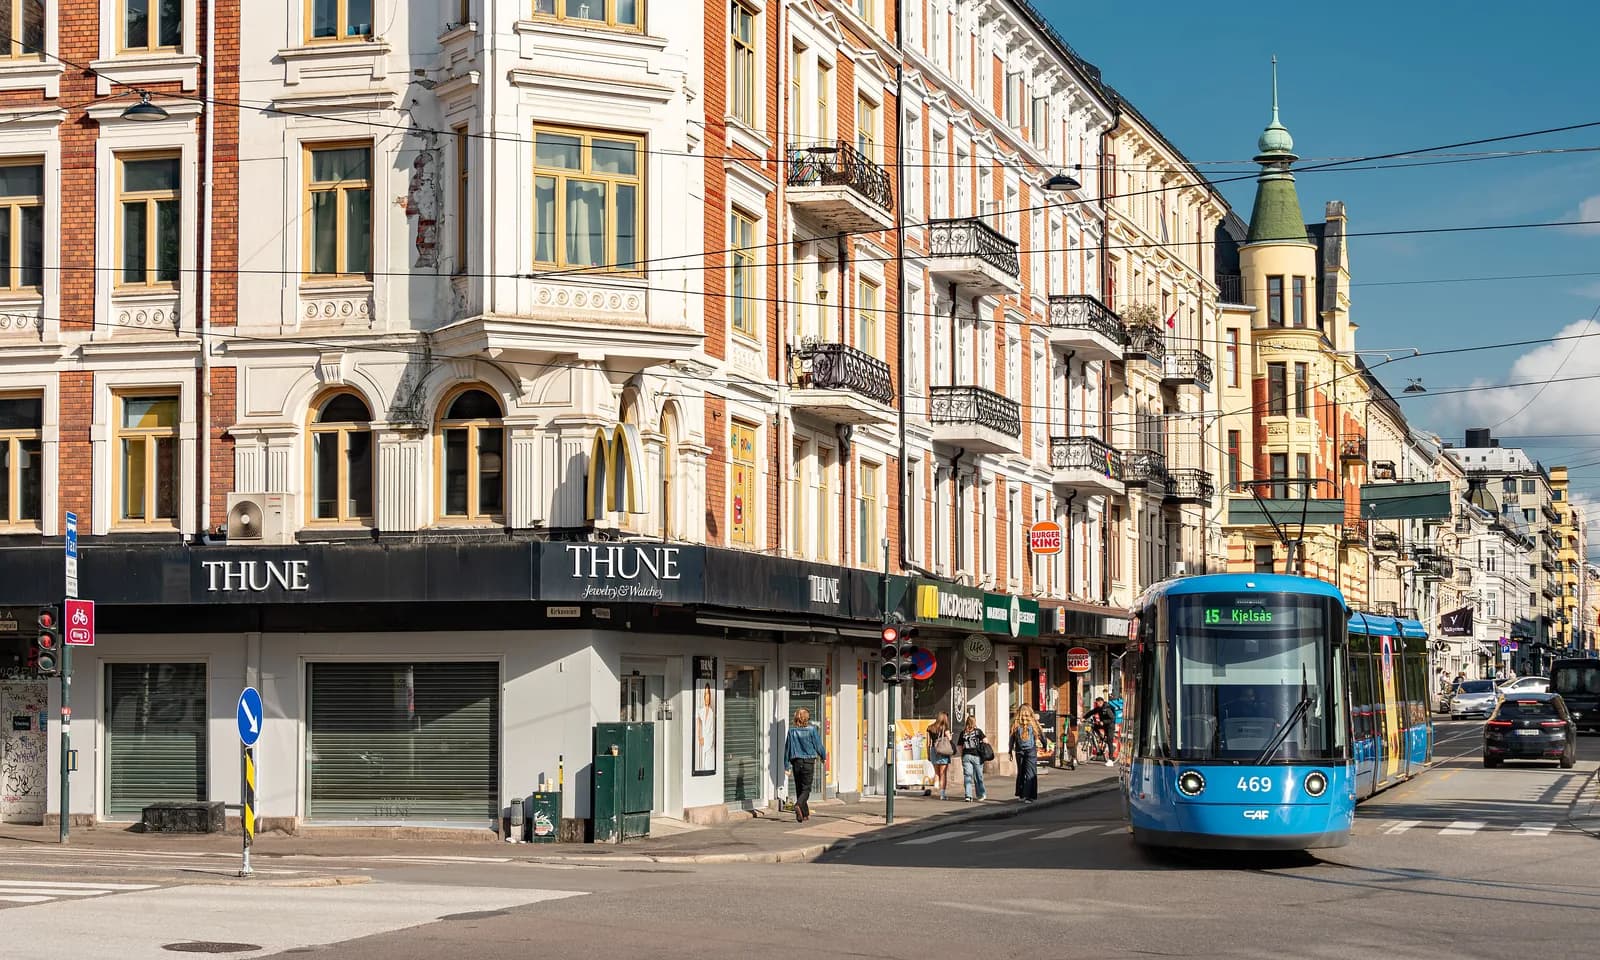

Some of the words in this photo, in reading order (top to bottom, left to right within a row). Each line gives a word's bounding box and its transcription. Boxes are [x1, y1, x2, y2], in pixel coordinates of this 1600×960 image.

[1031, 531, 1060, 539] BURGER
[1031, 539, 1060, 548] KING
[566, 544, 681, 580] THUNE
[201, 560, 310, 591] THUNE
[581, 584, 618, 599] Jewelry
[617, 584, 630, 597] &
[630, 582, 664, 600] Watches
[808, 574, 840, 604] THUNE
[939, 592, 983, 620] McDonald's
[1205, 609, 1220, 624] 15
[1231, 609, 1273, 625] Kjelsås
[1067, 659, 1089, 667] KING
[1237, 776, 1272, 792] 469
[1243, 810, 1270, 820] CAF
